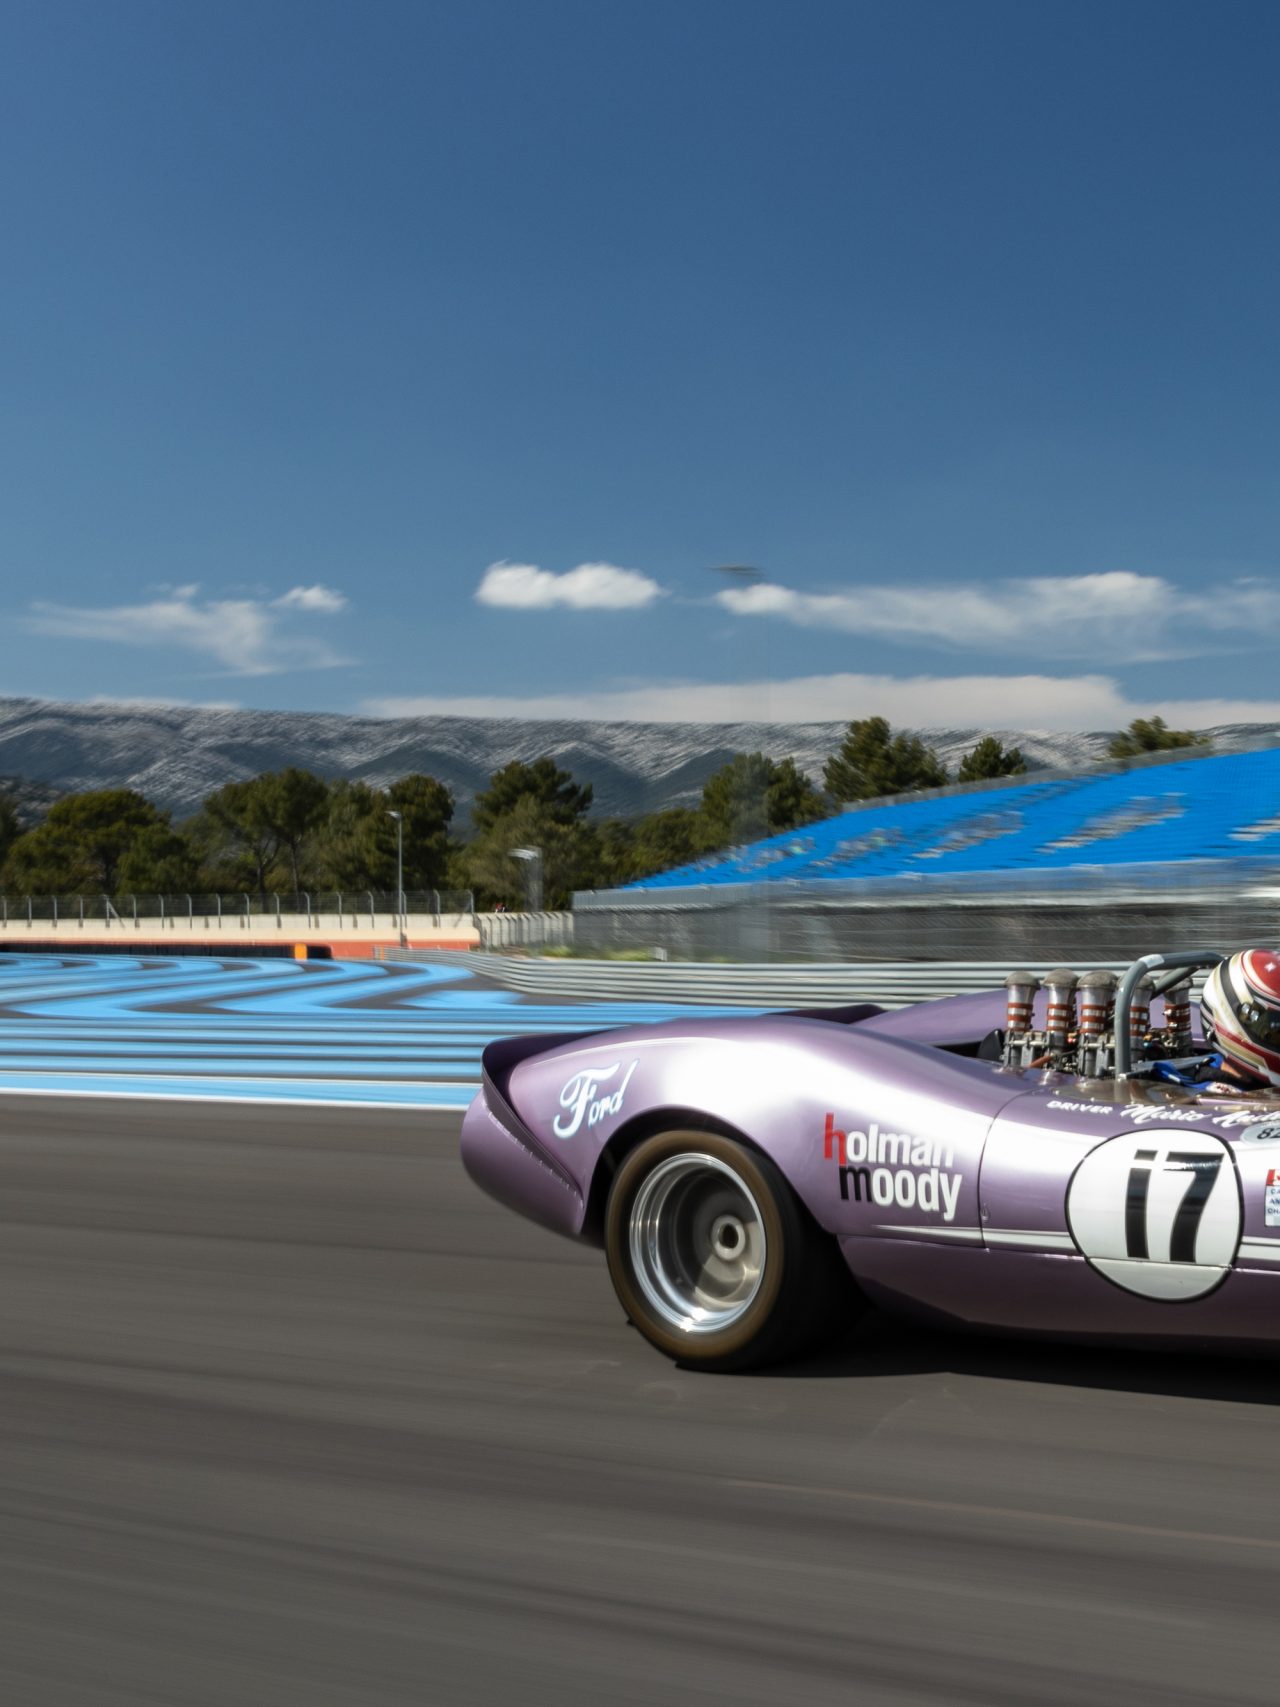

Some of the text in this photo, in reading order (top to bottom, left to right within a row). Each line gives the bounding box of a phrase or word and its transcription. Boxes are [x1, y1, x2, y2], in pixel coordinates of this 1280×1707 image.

[553, 1059, 639, 1139] Ford
[1046, 1100, 1113, 1115] DRIVER
[823, 1112, 955, 1168] holman
[838, 1165, 963, 1222] moody
[1124, 1148, 1226, 1264] 17
